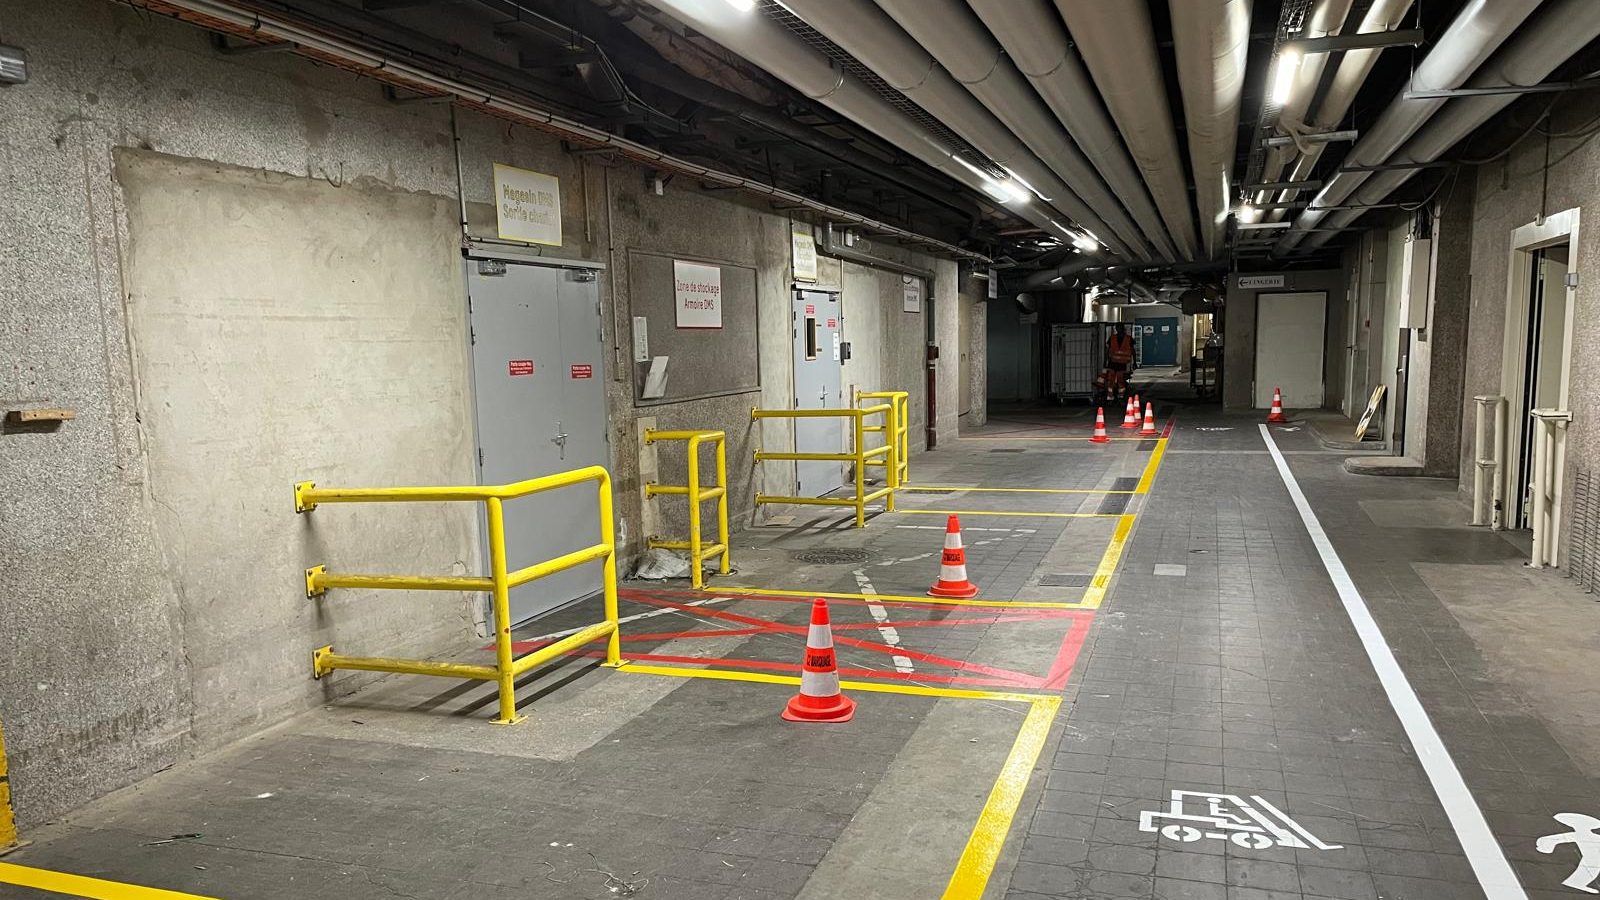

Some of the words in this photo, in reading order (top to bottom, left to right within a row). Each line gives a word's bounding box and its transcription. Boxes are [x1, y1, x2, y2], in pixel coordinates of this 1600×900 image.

[677, 279, 690, 292] Zone
[690, 280, 697, 293] de
[697, 281, 720, 297] stockage
[684, 298, 703, 310] Armoire
